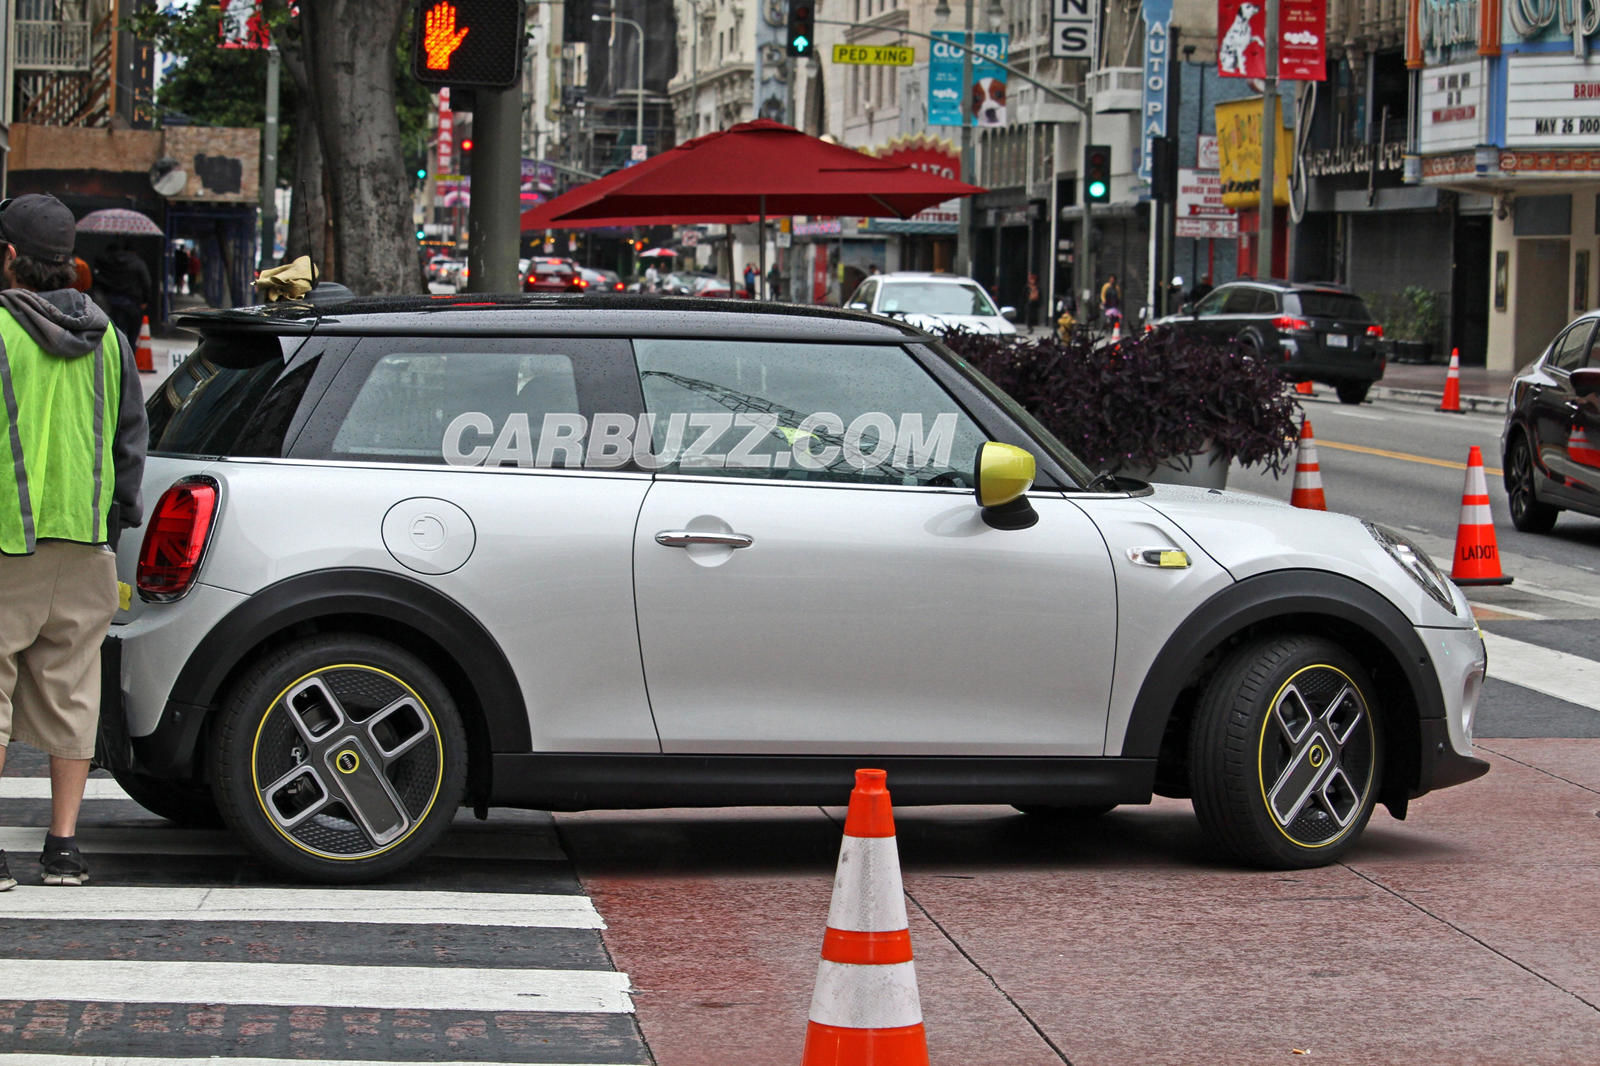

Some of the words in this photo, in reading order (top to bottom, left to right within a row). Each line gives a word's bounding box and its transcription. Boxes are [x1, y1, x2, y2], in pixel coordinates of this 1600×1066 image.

[838, 47, 868, 62] PED
[874, 49, 908, 63] XING
[1535, 118, 1557, 135] MAY
[1561, 118, 1574, 134] 26
[1461, 545, 1496, 561] LADOT
